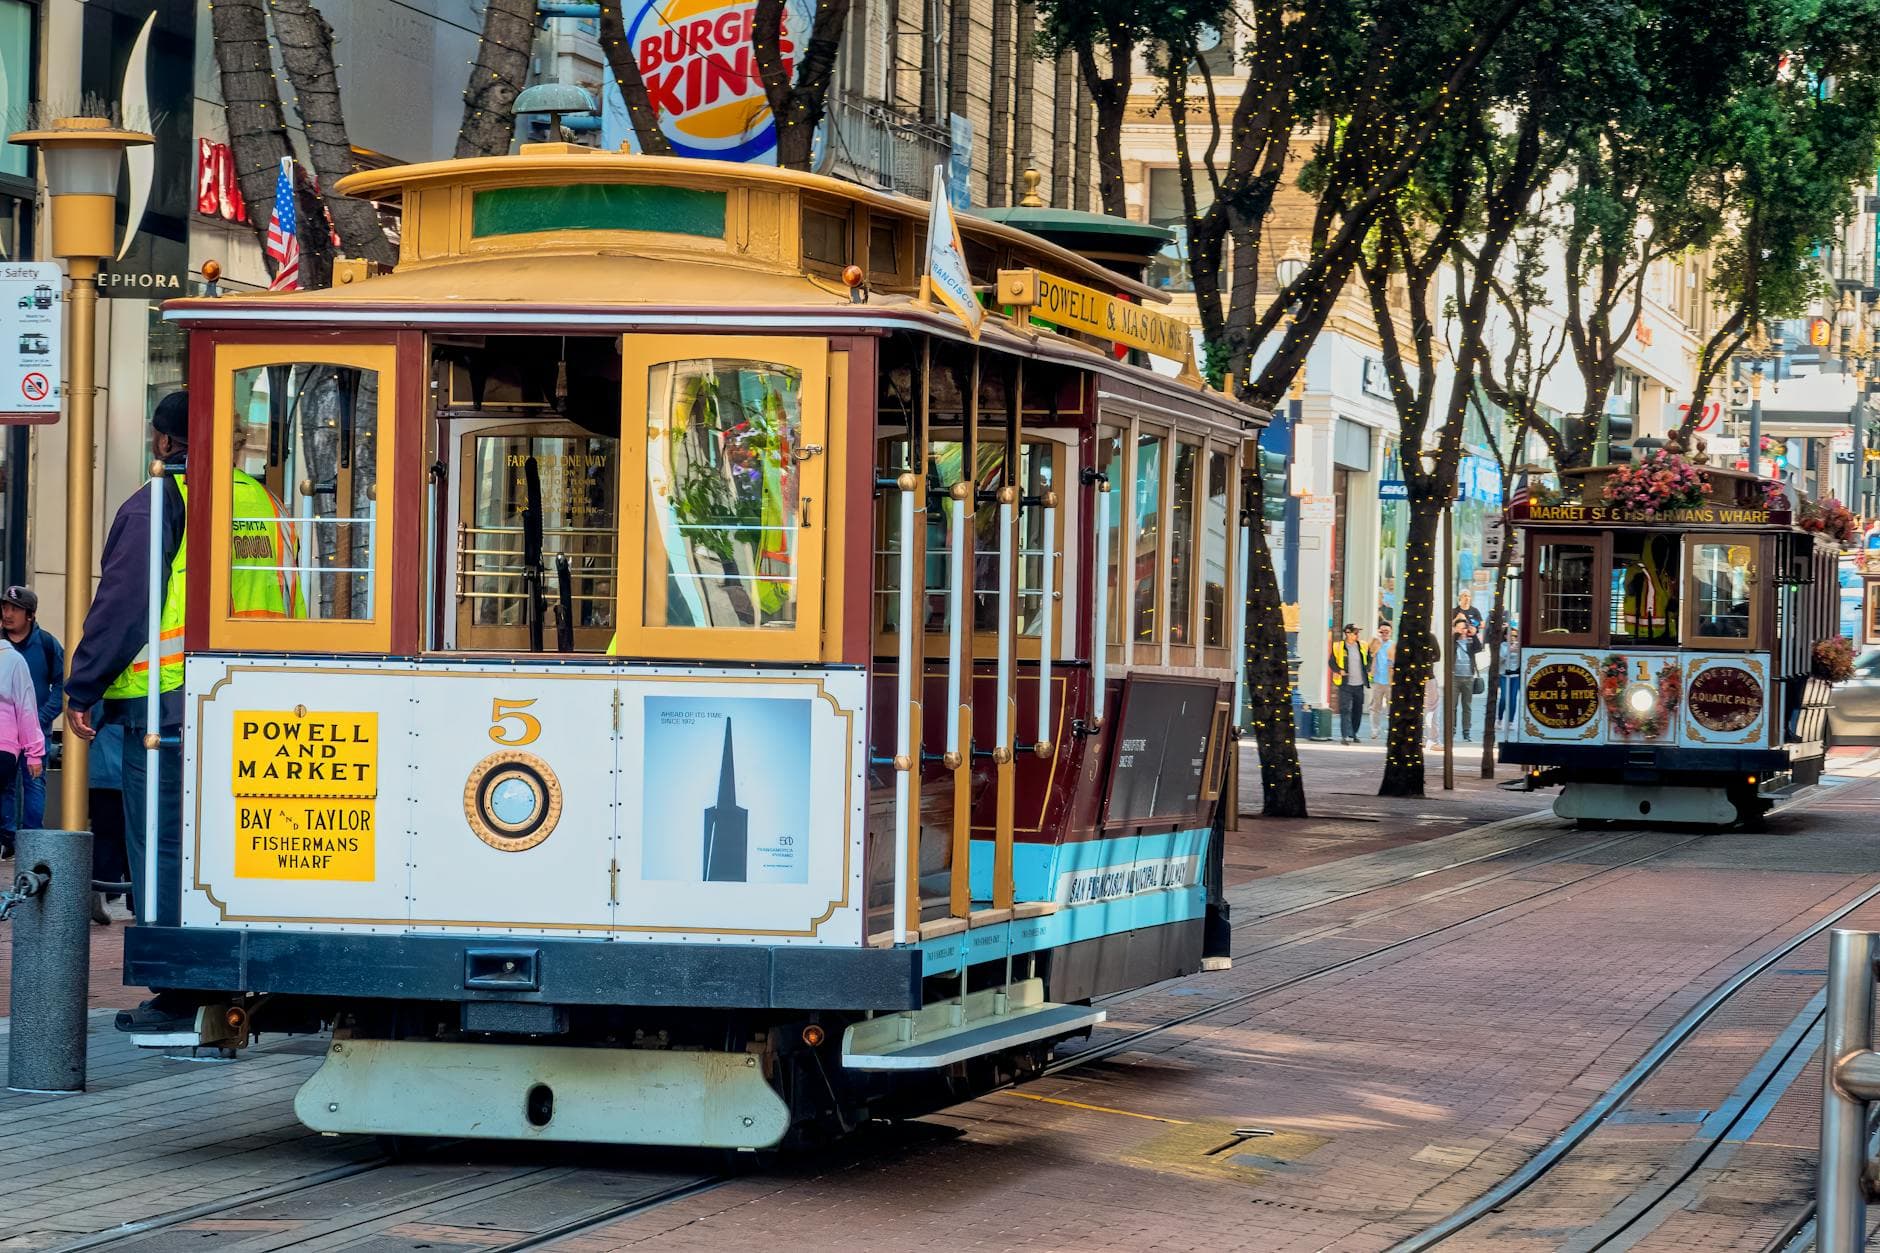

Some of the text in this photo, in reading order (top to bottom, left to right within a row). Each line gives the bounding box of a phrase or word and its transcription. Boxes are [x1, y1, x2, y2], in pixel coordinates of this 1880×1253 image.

[5, 268, 39, 279] Safety
[97, 273, 180, 288] EPHORA
[1038, 280, 1098, 325] POWELL
[1106, 301, 1117, 332] &
[1120, 307, 1168, 347] MASON
[584, 455, 607, 468] WAY
[1529, 506, 1586, 520] MARKET
[1719, 510, 1771, 522] WHARF
[232, 521, 267, 531] SFMTA
[1637, 660, 1650, 681] 1
[488, 697, 542, 747] 5
[242, 721, 370, 743] POWELL
[274, 743, 337, 759] AND
[237, 760, 370, 781] MARKET
[240, 808, 371, 832] BAY AND TAYLOR
[252, 836, 359, 852] FISHERMANS
[277, 854, 333, 869] WHARF
